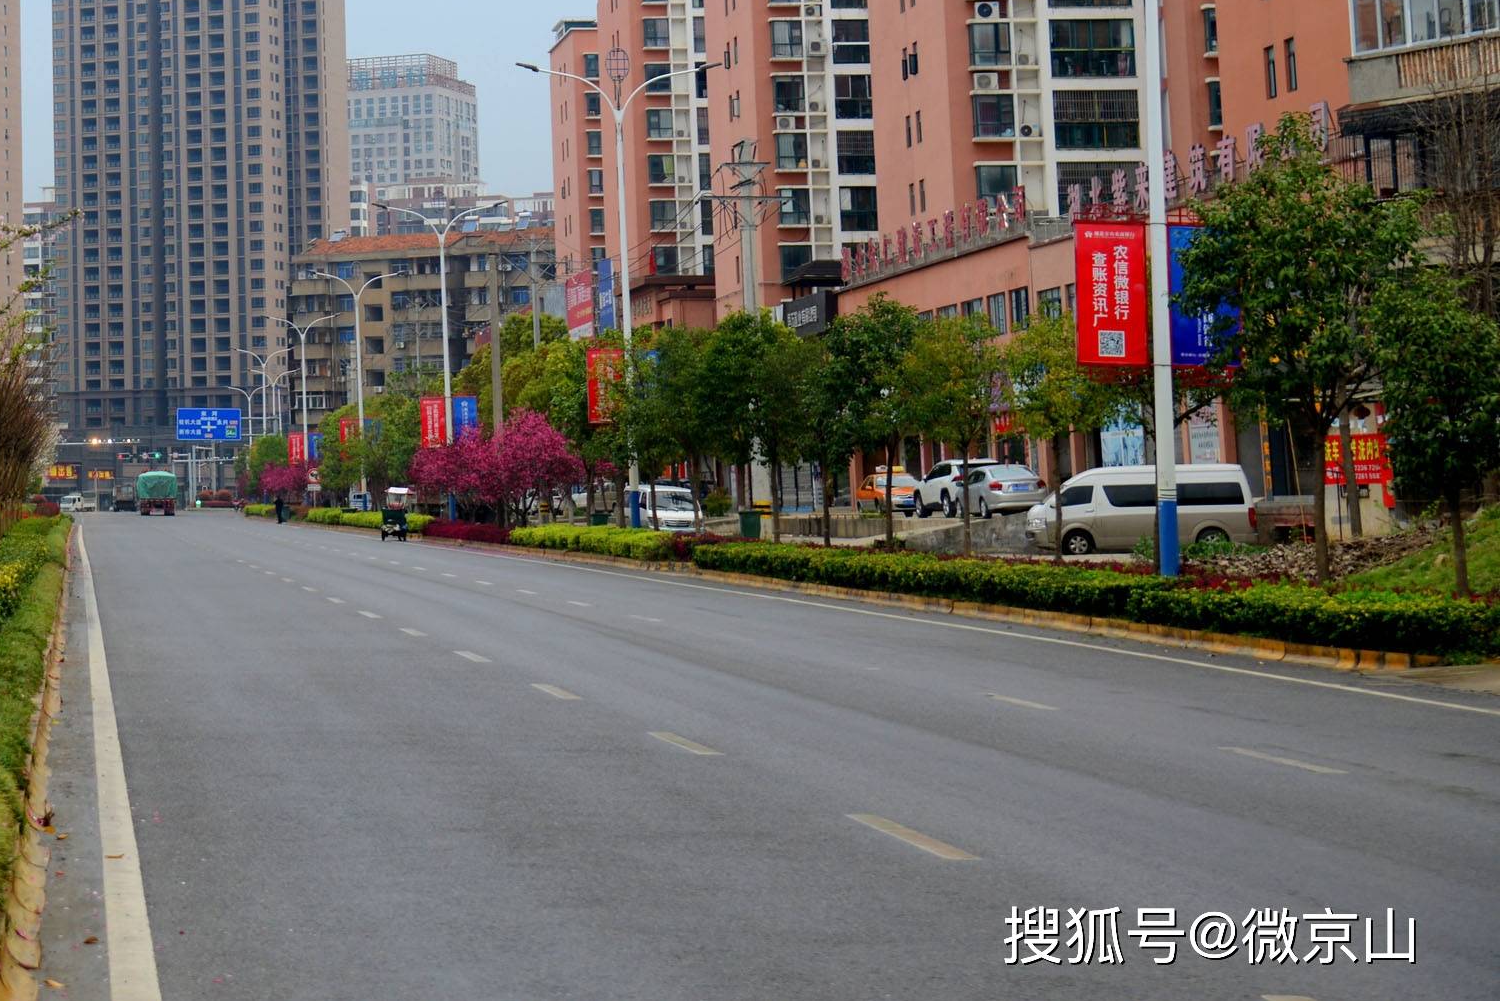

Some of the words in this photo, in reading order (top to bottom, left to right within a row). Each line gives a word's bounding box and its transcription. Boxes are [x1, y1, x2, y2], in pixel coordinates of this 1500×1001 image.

[1092, 251, 1109, 327] 查账资讯广
[1113, 245, 1130, 320] 农信微银行
